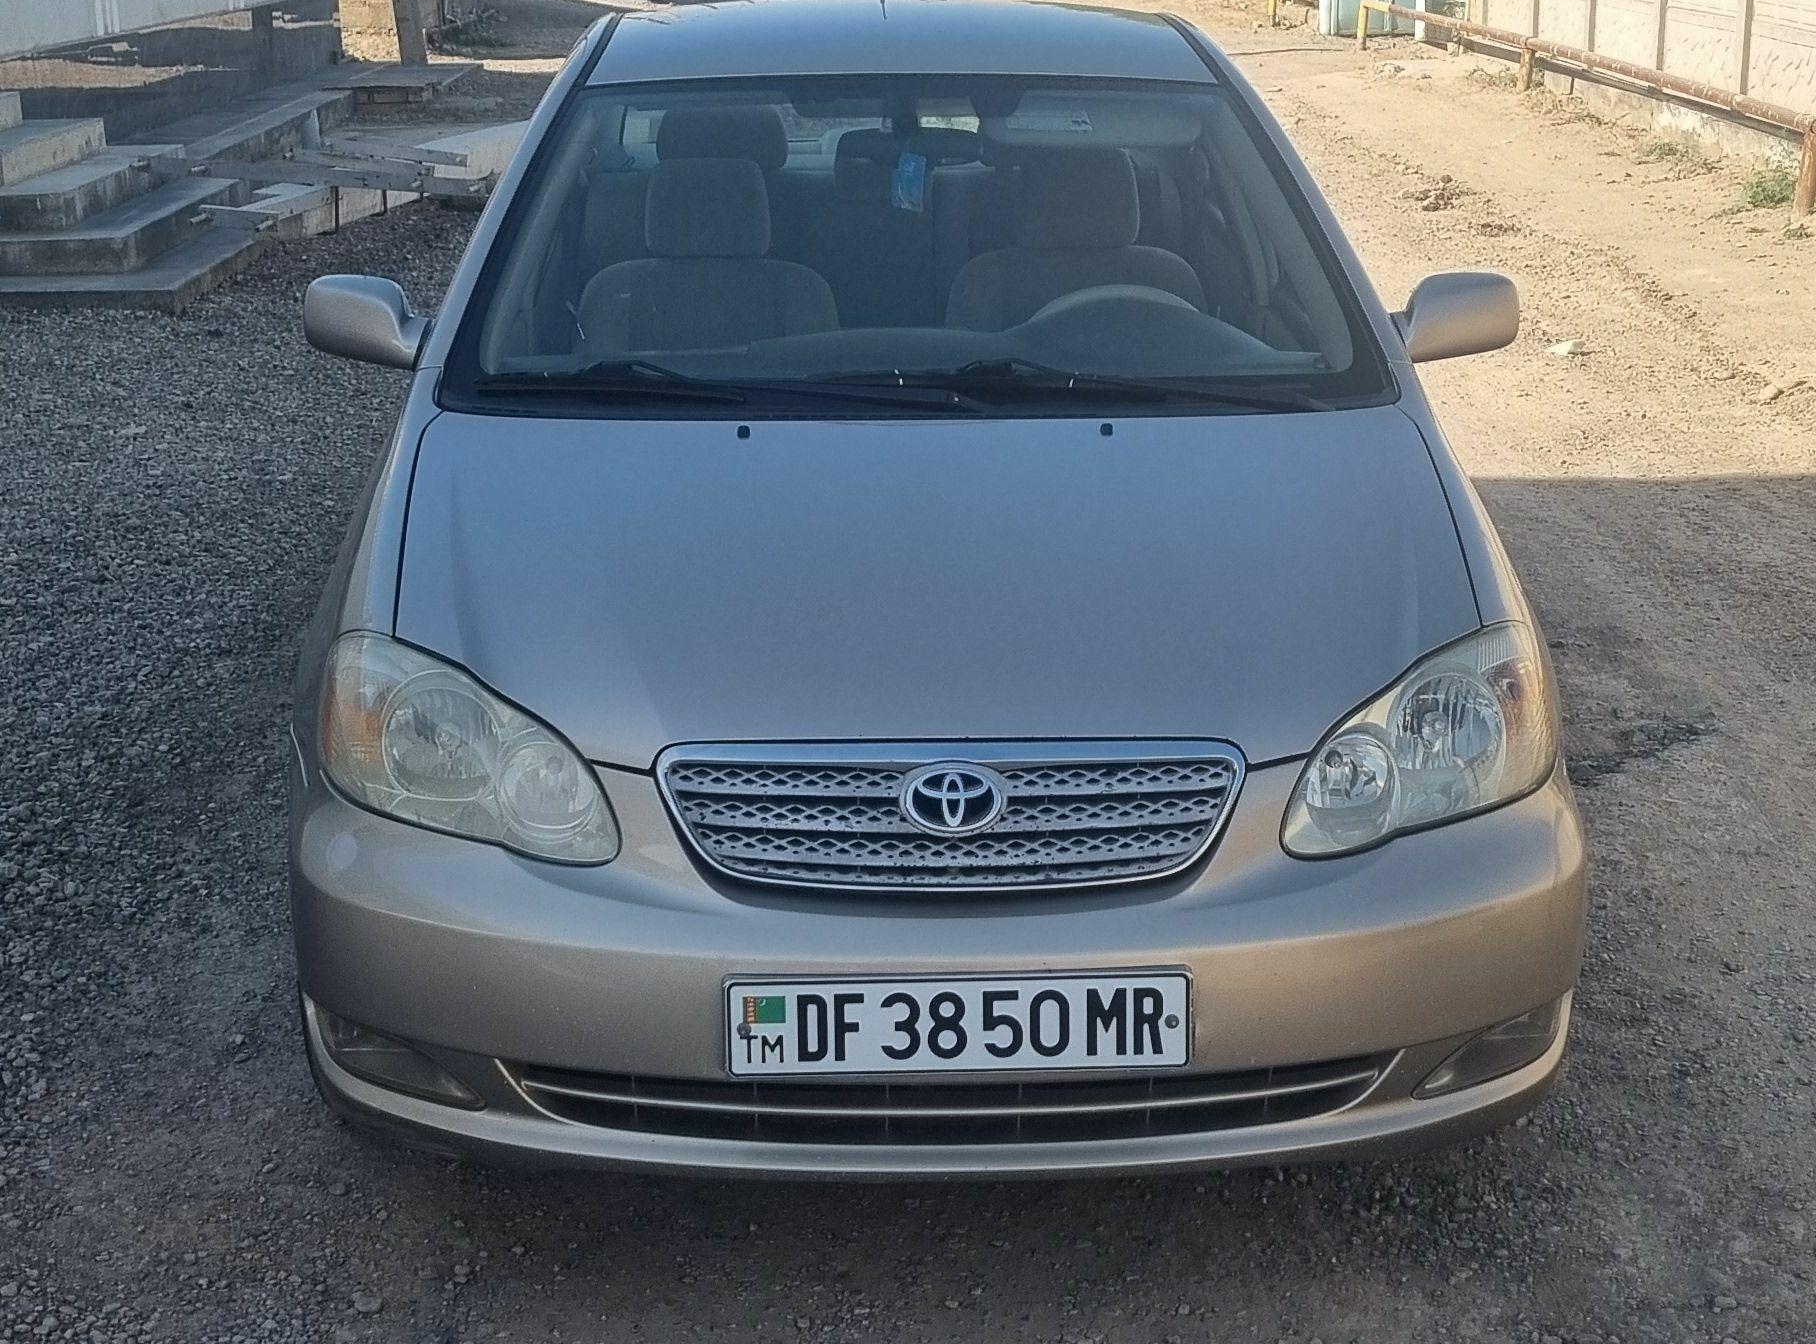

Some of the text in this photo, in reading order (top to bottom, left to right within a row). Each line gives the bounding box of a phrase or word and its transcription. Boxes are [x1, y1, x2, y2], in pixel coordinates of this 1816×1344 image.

[741, 1033, 785, 1063] TM
[796, 992, 865, 1063] DF
[1086, 987, 1164, 1057] MR
